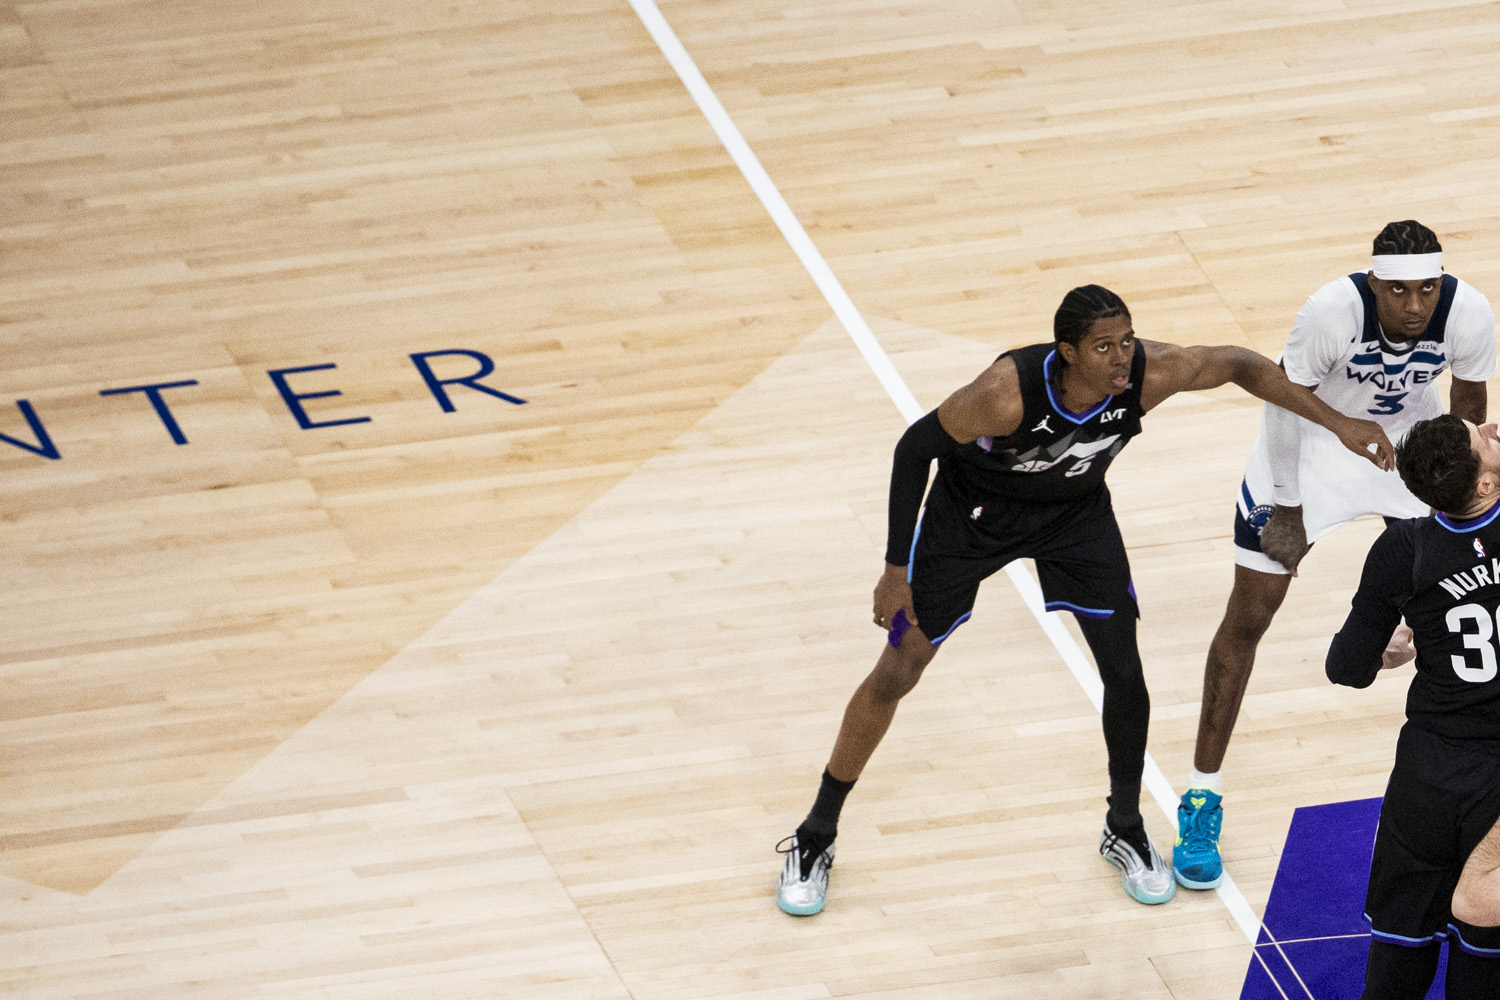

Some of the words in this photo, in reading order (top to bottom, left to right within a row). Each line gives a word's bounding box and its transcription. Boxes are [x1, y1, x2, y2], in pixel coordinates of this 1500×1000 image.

[1346, 365, 1446, 392] WOLVES
[1367, 391, 1409, 415] 3
[1100, 408, 1127, 423] LVT
[1064, 454, 1097, 477] 5
